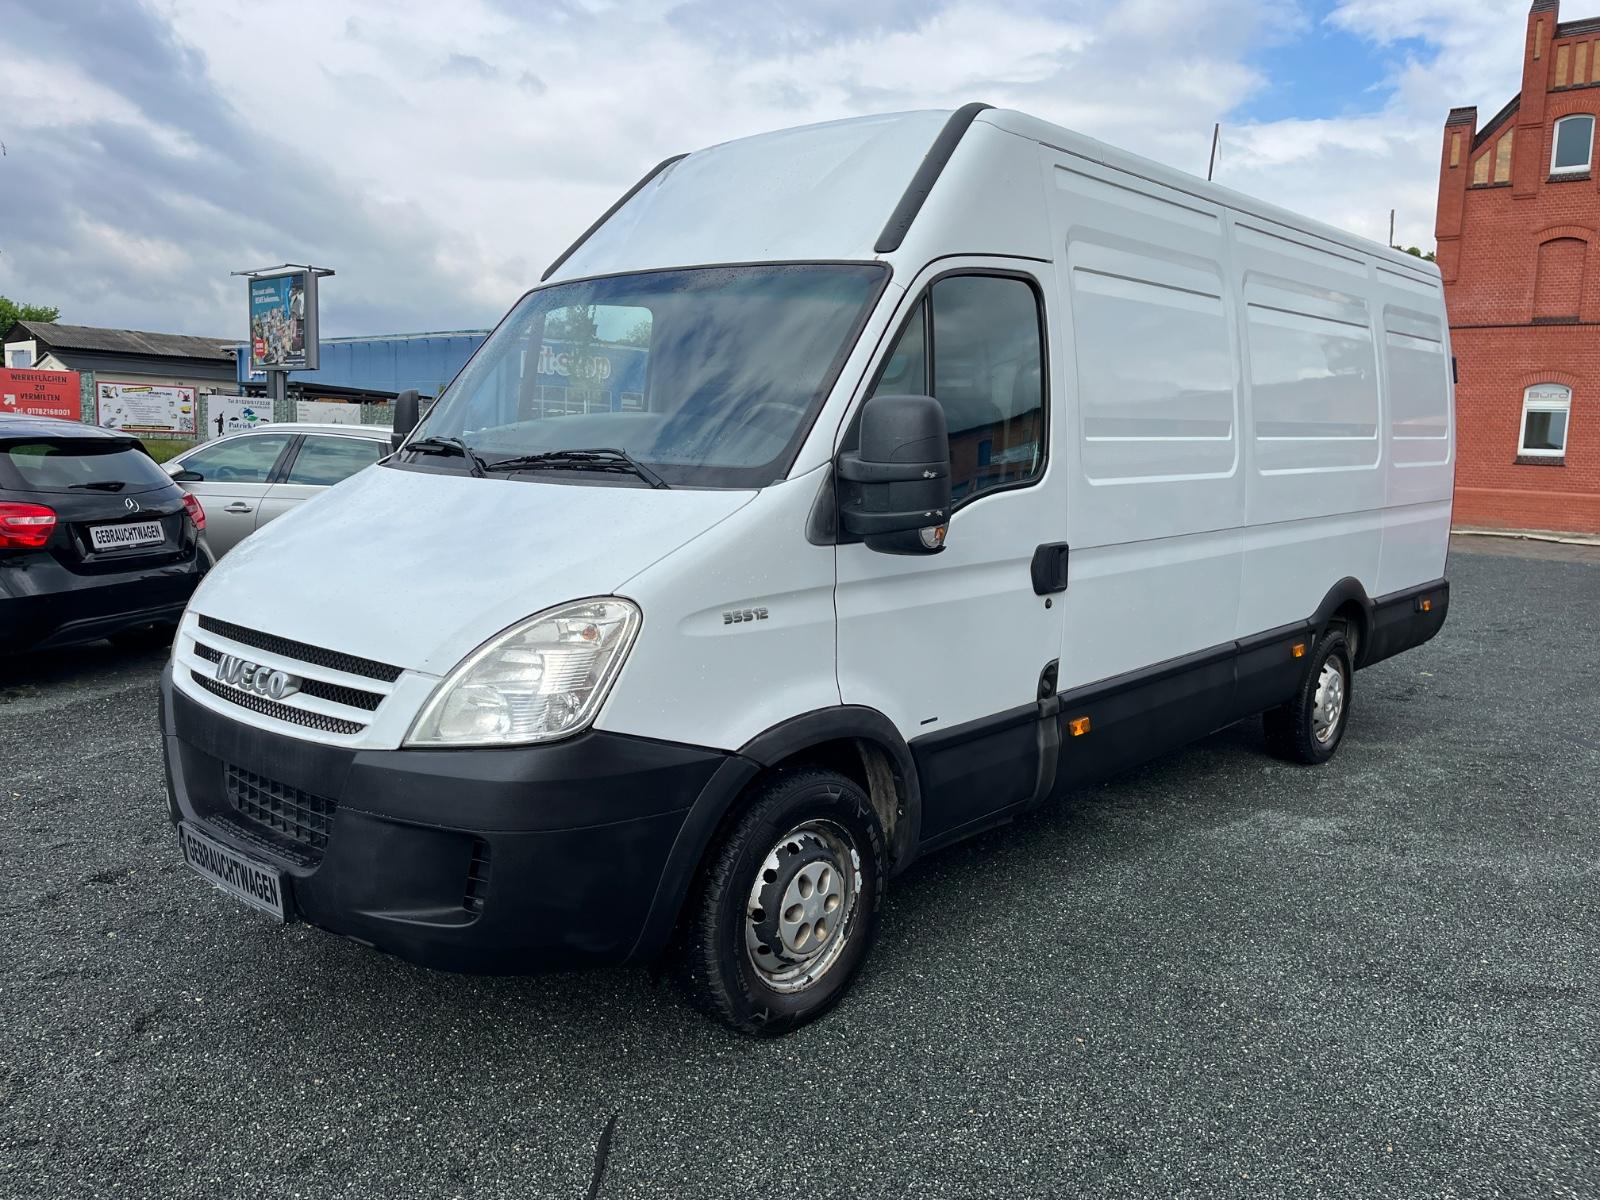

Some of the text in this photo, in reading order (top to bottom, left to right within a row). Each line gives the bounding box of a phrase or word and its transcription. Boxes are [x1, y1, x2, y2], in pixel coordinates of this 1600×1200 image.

[20, 393, 60, 401] VERMIETEN
[95, 525, 160, 544] GEBRAUCHTWAGEN
[215, 653, 290, 700] IVECO
[187, 834, 279, 907] GEBRAUCHTWAGEN
